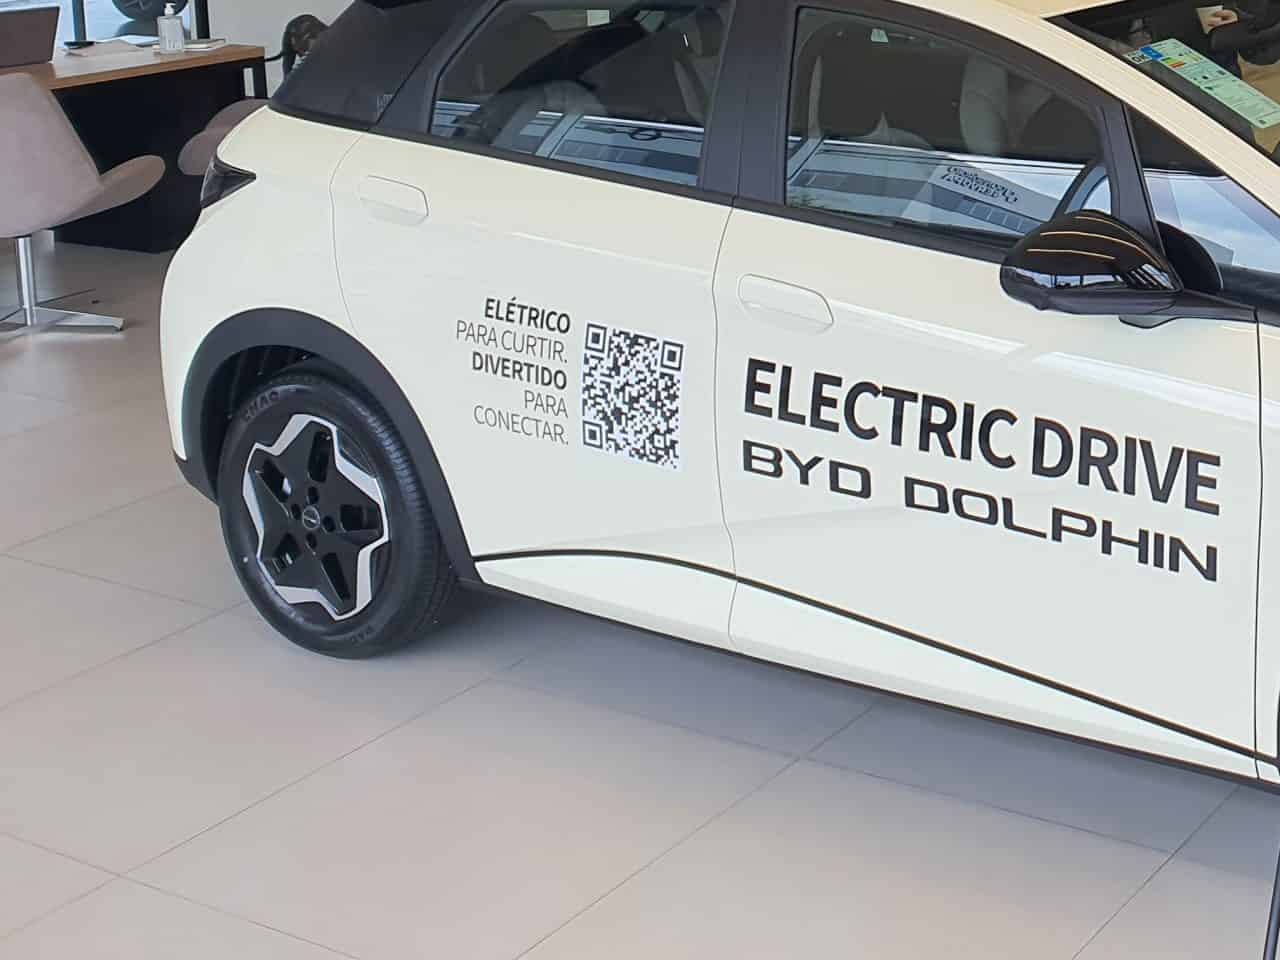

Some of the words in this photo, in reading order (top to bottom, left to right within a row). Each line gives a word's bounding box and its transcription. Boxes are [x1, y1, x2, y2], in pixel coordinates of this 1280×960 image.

[485, 297, 571, 334] ELÉTRICO
[456, 320, 498, 348] PARA
[501, 330, 568, 363] CURTIR.
[472, 352, 567, 390] DIVERTIDO
[524, 390, 568, 418] PARA
[473, 405, 569, 445] CONECTAR.
[744, 357, 1019, 469] ELECTRIC
[1032, 416, 1221, 515] DRIVE
[743, 440, 872, 499] BYD
[904, 476, 1218, 582] DOLPHIN
